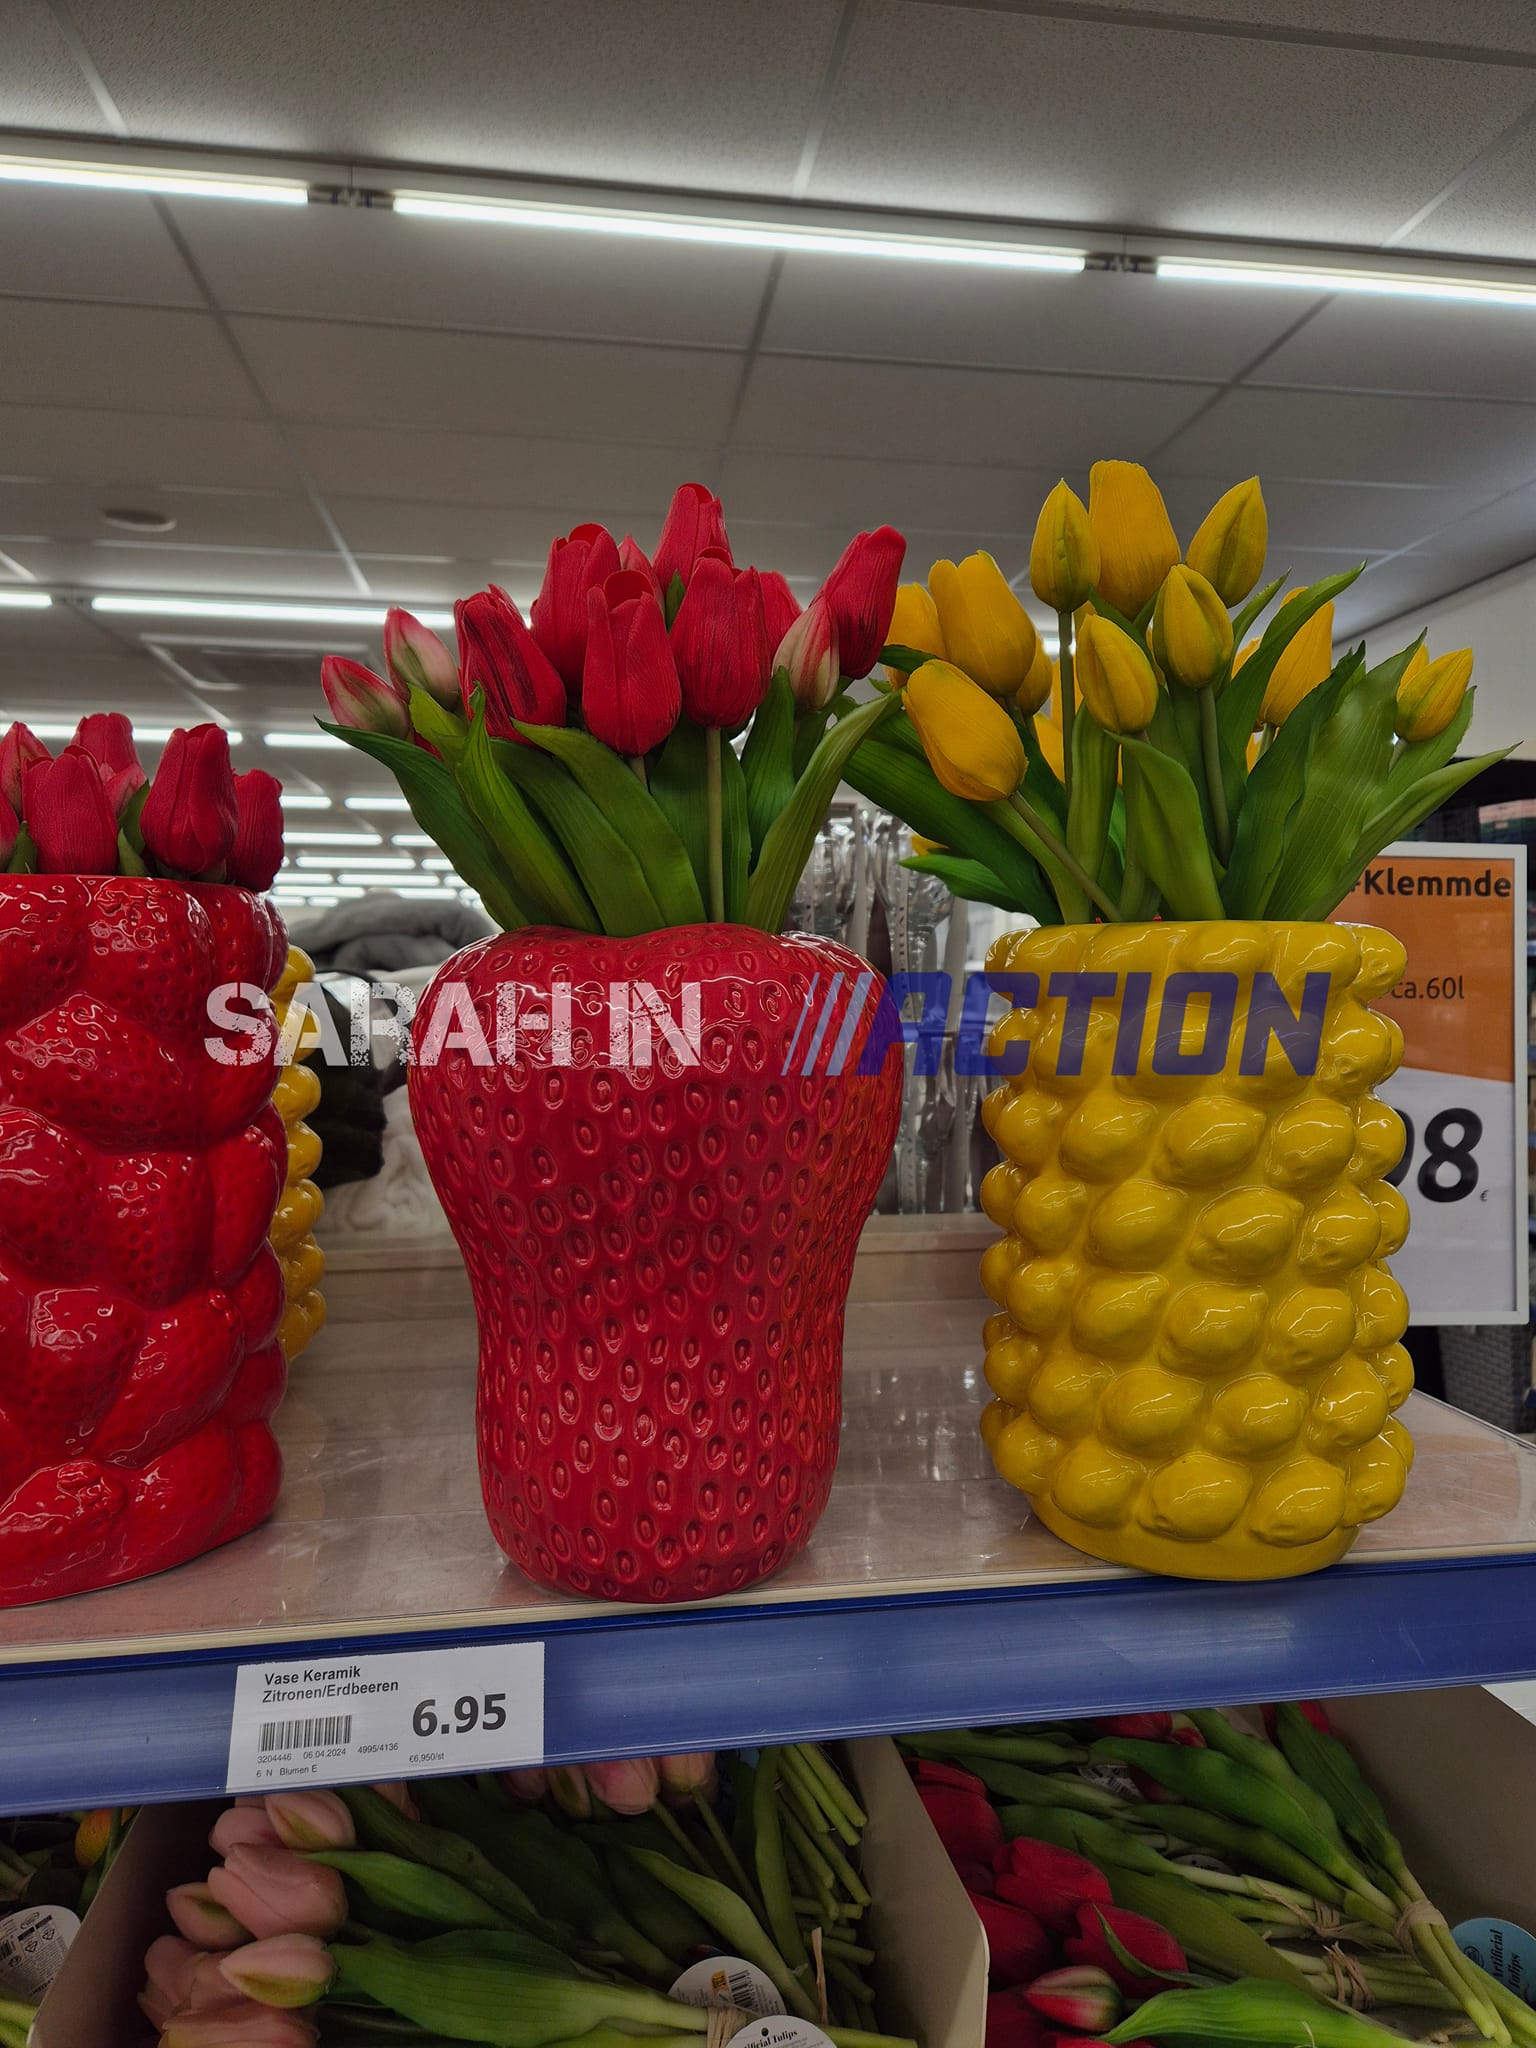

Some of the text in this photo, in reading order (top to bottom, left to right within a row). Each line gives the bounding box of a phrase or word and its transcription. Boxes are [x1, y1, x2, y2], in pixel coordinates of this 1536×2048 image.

[264, 1665, 361, 1686] Vase Keramik
[262, 1681, 399, 1704] Zitronen/Erdbeeren
[412, 1693, 507, 1737] 6.95
[257, 1742, 399, 1765] 3204446 06.04.2024 4995/4136
[266, 1768, 273, 1777] N
[279, 1765, 310, 1777] Blumen
[311, 1764, 318, 1773] E
